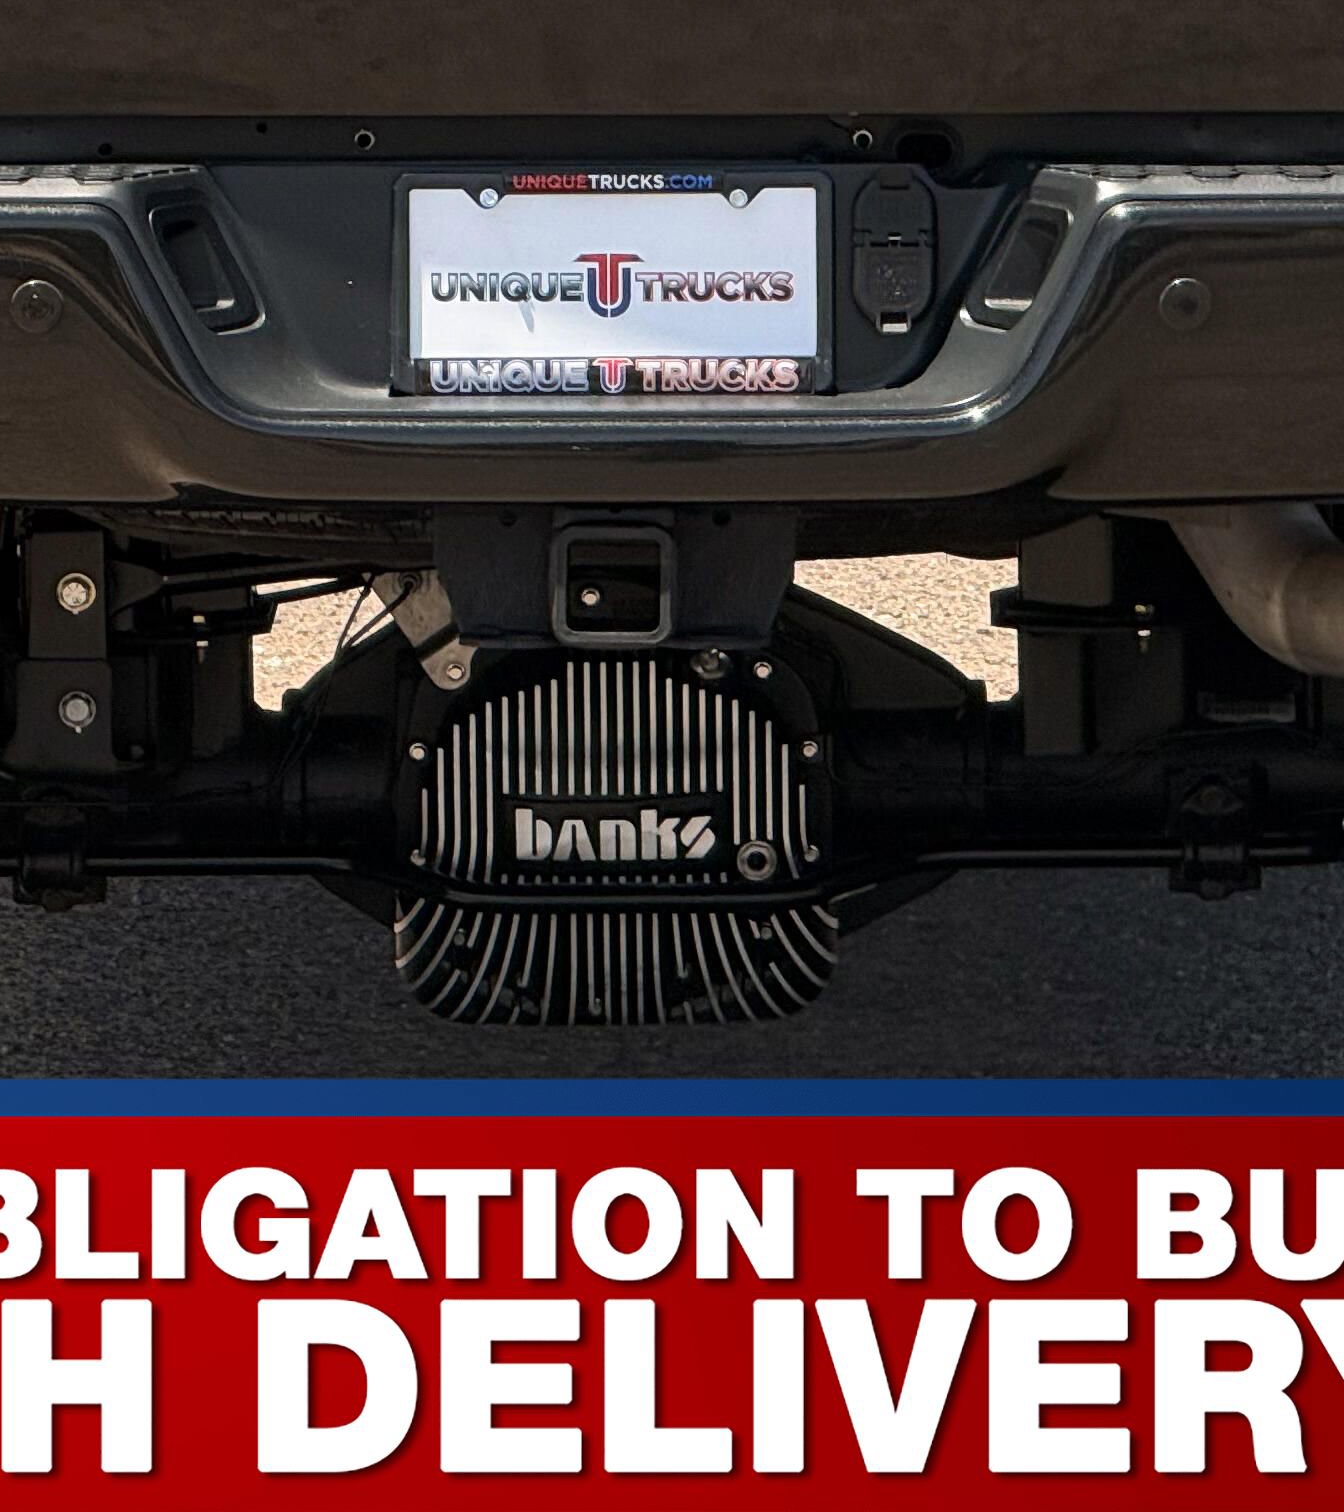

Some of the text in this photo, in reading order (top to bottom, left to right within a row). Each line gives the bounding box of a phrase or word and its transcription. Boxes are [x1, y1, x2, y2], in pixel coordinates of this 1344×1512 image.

[512, 174, 713, 190] UNIQUETRUCKS.COM
[431, 272, 584, 303] UNIQUE
[635, 272, 794, 302] TRUCKS
[429, 359, 588, 393] UNIQUE
[634, 358, 799, 393] TRUCKS
[515, 808, 716, 861] banks
